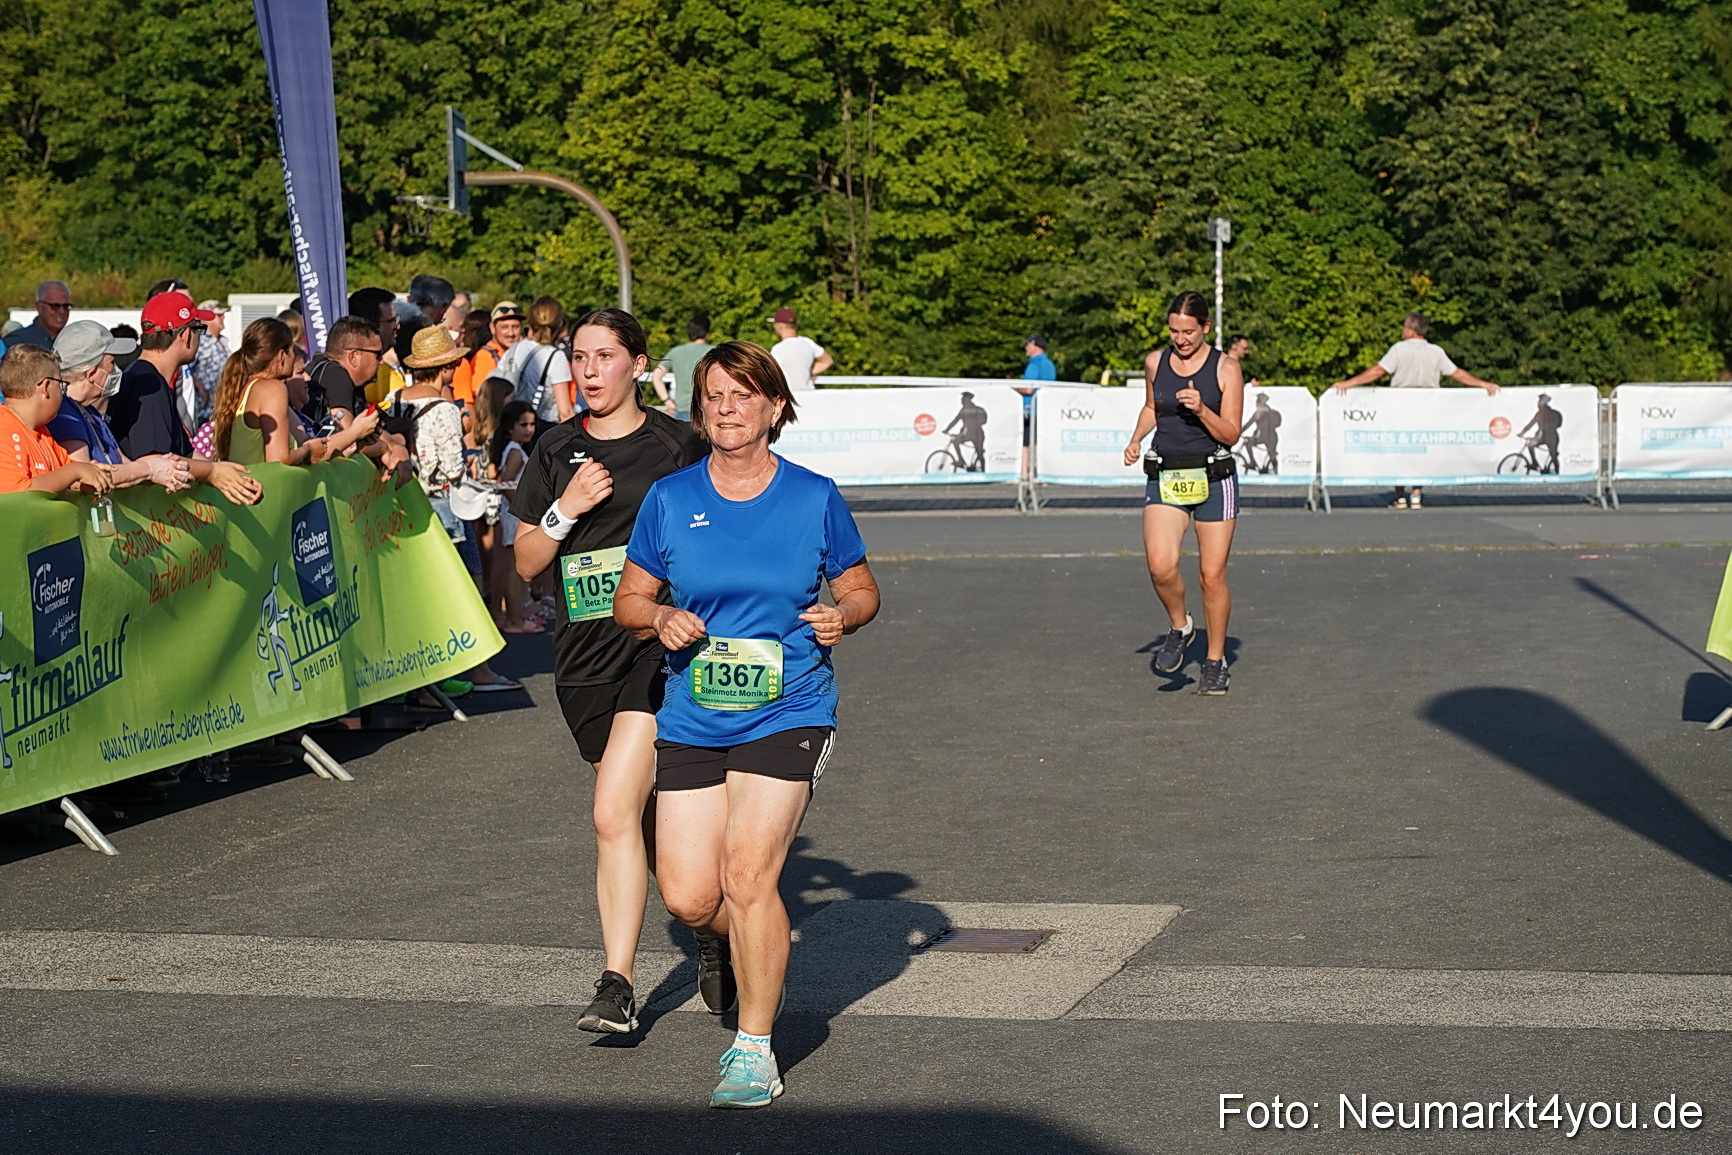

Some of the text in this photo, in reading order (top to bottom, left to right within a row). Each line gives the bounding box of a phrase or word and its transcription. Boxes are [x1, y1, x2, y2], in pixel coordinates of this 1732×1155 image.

[1061, 408, 1095, 420] NOW
[1343, 409, 1377, 422] NOW
[1641, 407, 1677, 419] NOW
[1345, 431, 1397, 444] E-BIKES
[1398, 431, 1409, 444] &
[1172, 481, 1195, 494] 487
[689, 520, 710, 529] erima
[298, 530, 329, 556] Fischer
[39, 576, 76, 605] Fischer
[568, 585, 578, 609] RUN
[44, 595, 70, 616] AUTOMOBILE
[585, 596, 614, 608] Betz Pa
[11, 613, 130, 731] firmenlauf
[694, 668, 702, 693] RUN
[704, 661, 766, 688] 1367
[701, 686, 769, 698] Steinmetz Monika
[768, 669, 778, 700] 2022
[17, 711, 71, 758] neumarkt
